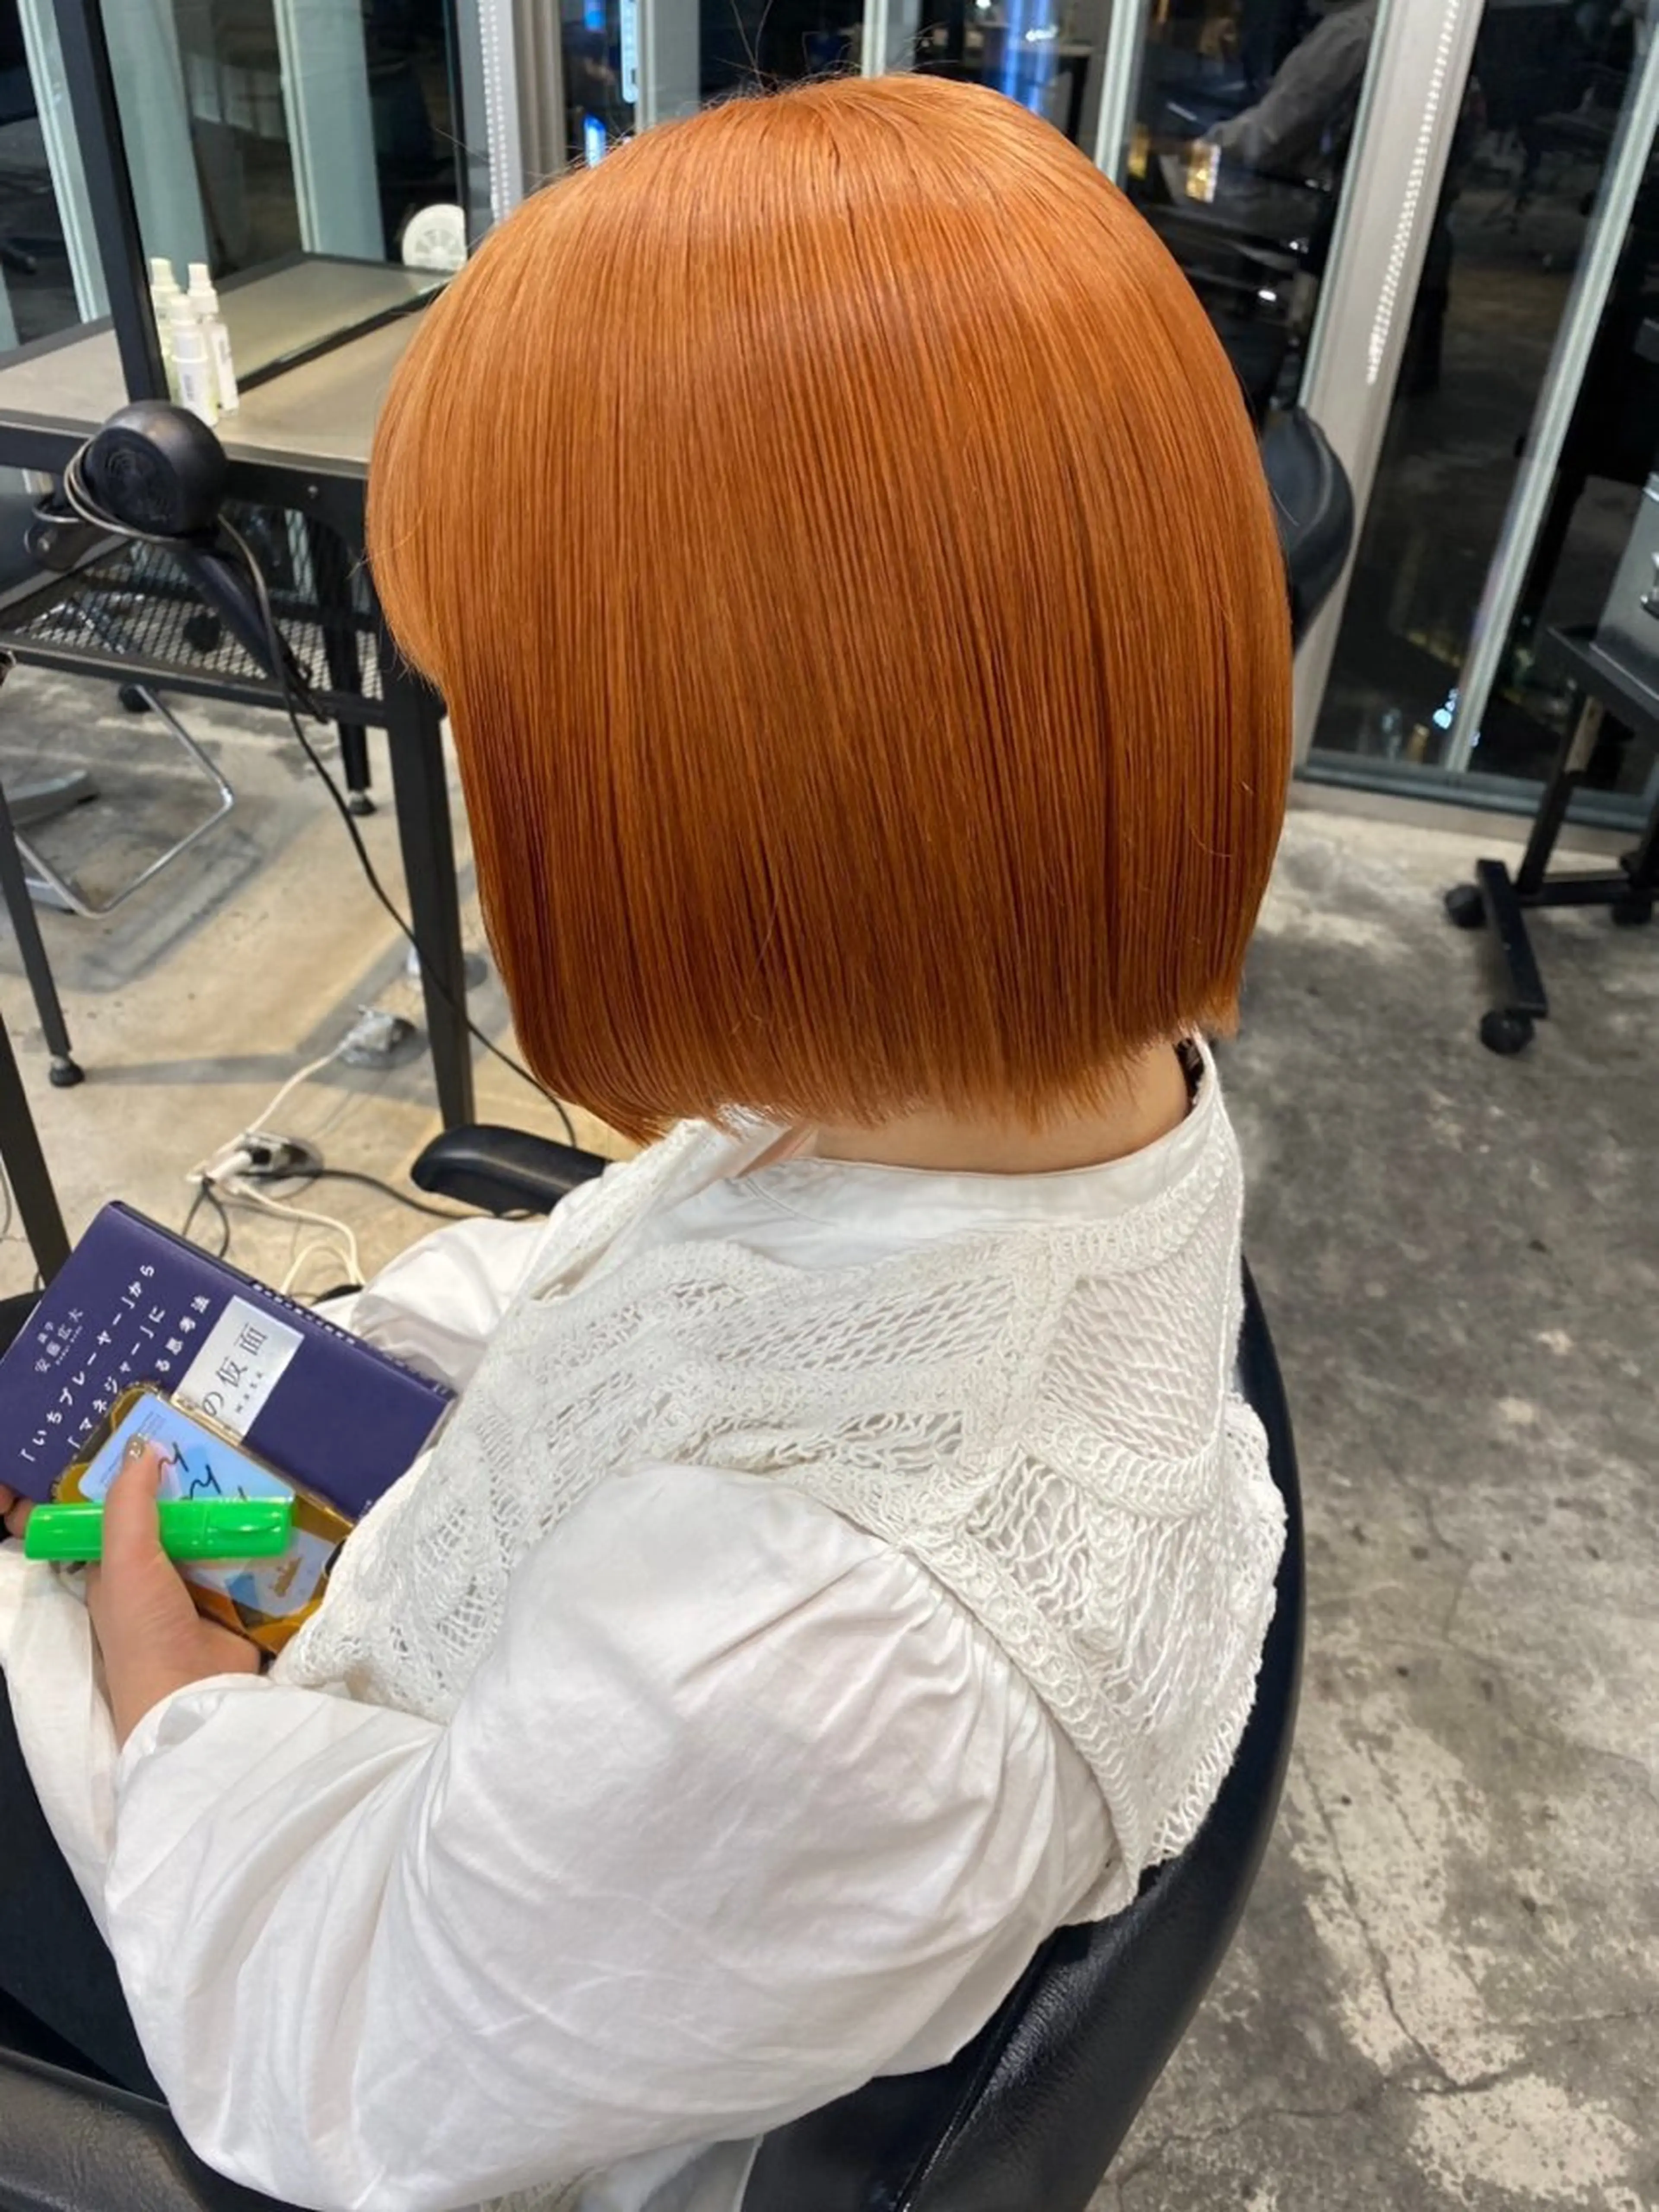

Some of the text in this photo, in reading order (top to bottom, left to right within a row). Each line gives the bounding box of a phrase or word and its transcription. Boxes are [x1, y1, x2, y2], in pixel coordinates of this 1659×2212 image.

[155, 1295, 210, 1373] る思考法
[202, 1322, 268, 1417] の仮面
